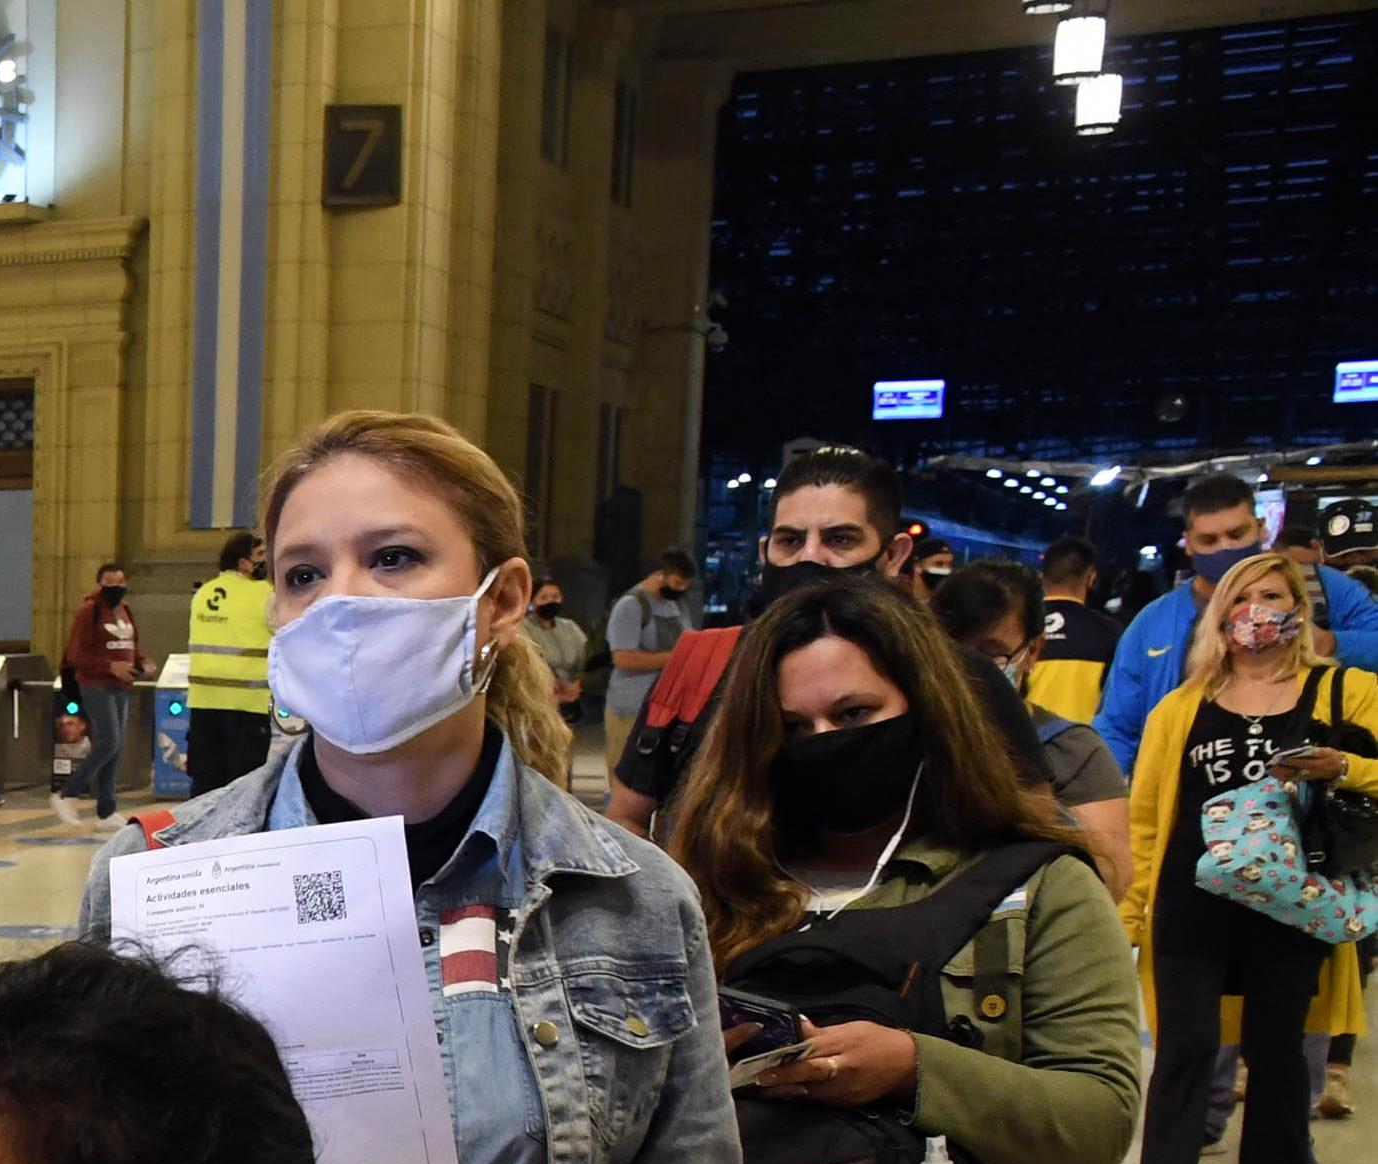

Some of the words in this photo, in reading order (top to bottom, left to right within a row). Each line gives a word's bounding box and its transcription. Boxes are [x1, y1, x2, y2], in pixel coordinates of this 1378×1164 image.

[339, 119, 386, 190] 7
[1188, 737, 1236, 768] THE
[1204, 759, 1232, 786] IS
[145, 888, 197, 904] Actividades
[199, 880, 250, 896] esenciales
